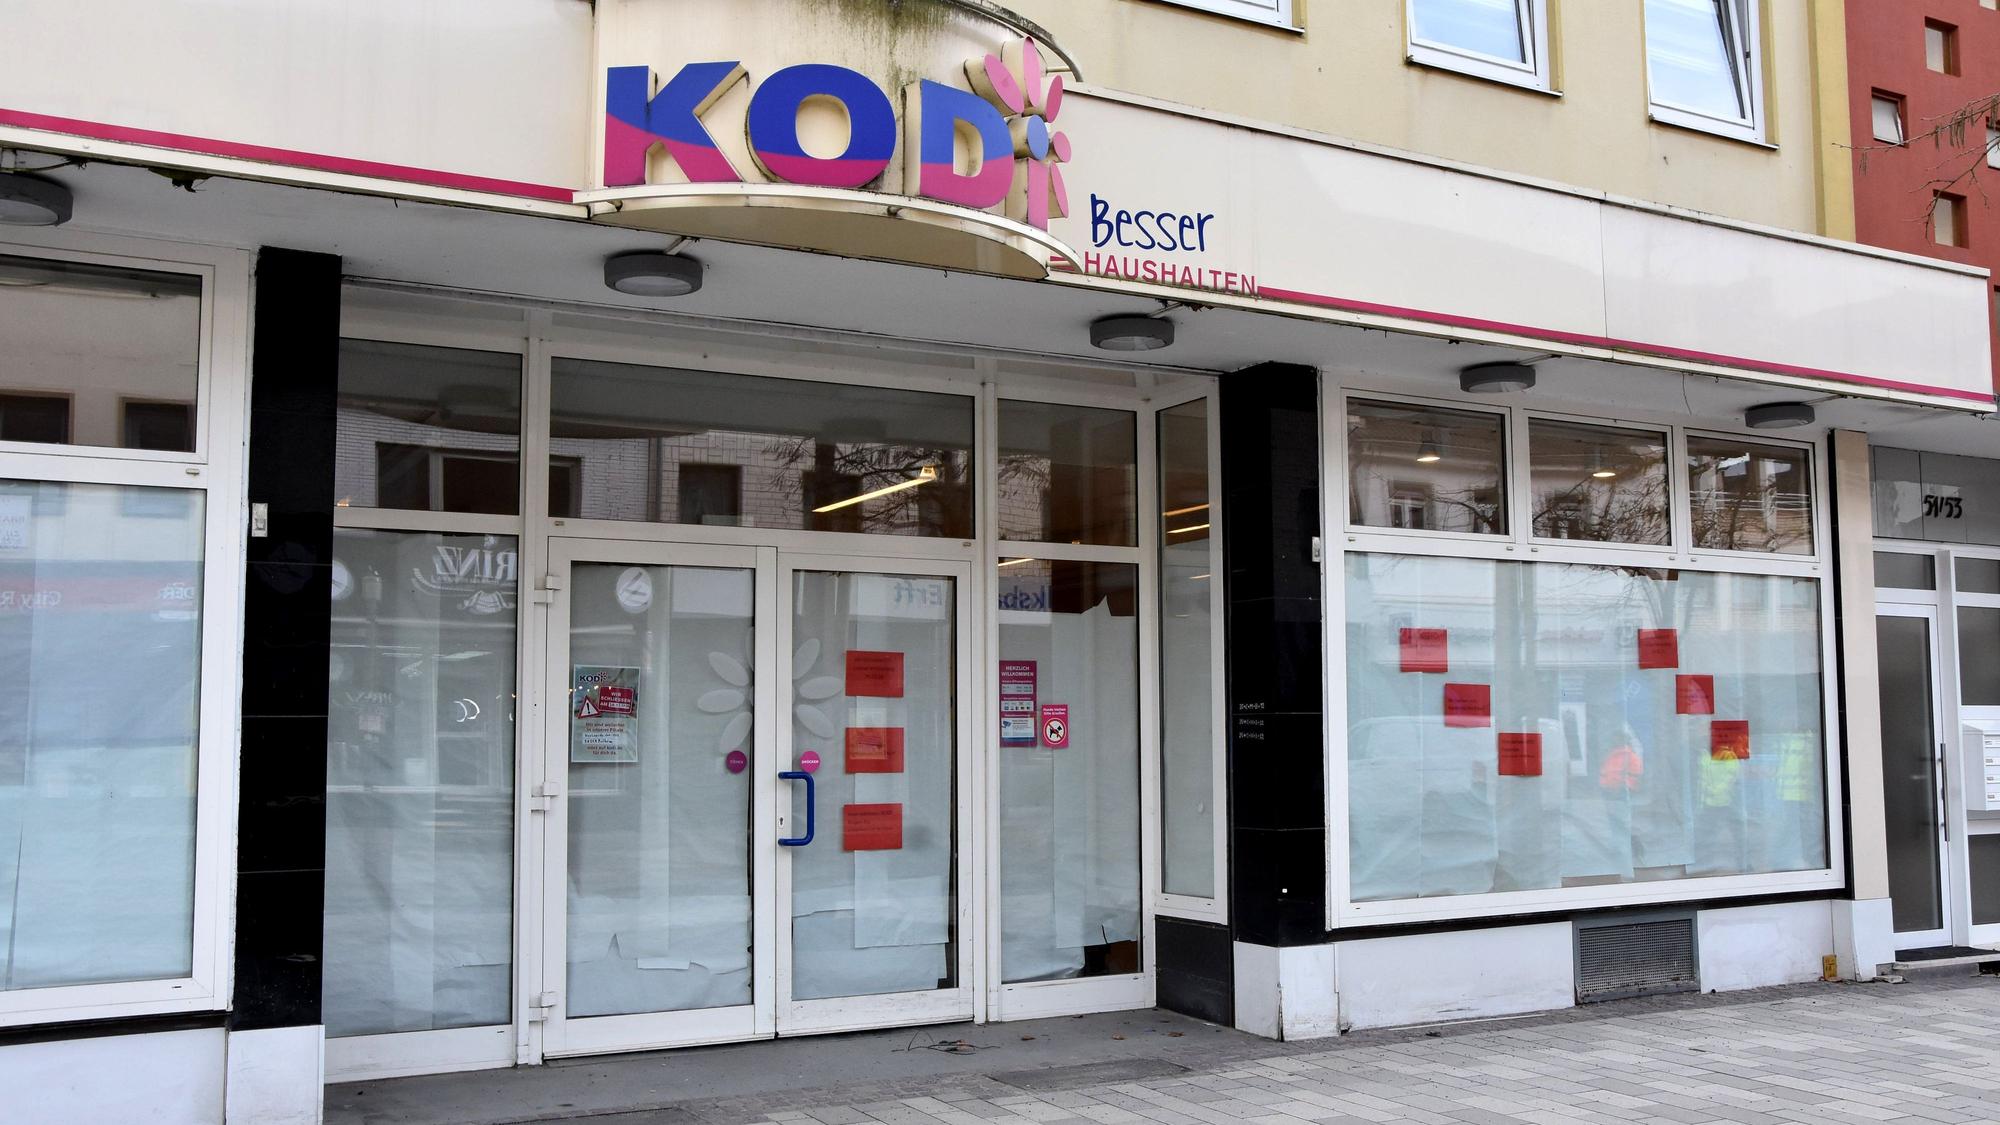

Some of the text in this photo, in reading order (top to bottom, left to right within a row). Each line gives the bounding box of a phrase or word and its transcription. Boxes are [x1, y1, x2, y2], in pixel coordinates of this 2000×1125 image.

[1091, 193, 1214, 252] Besser
[1084, 251, 1256, 295] HAUSHALTEN
[1923, 494, 1963, 519] 51/53
